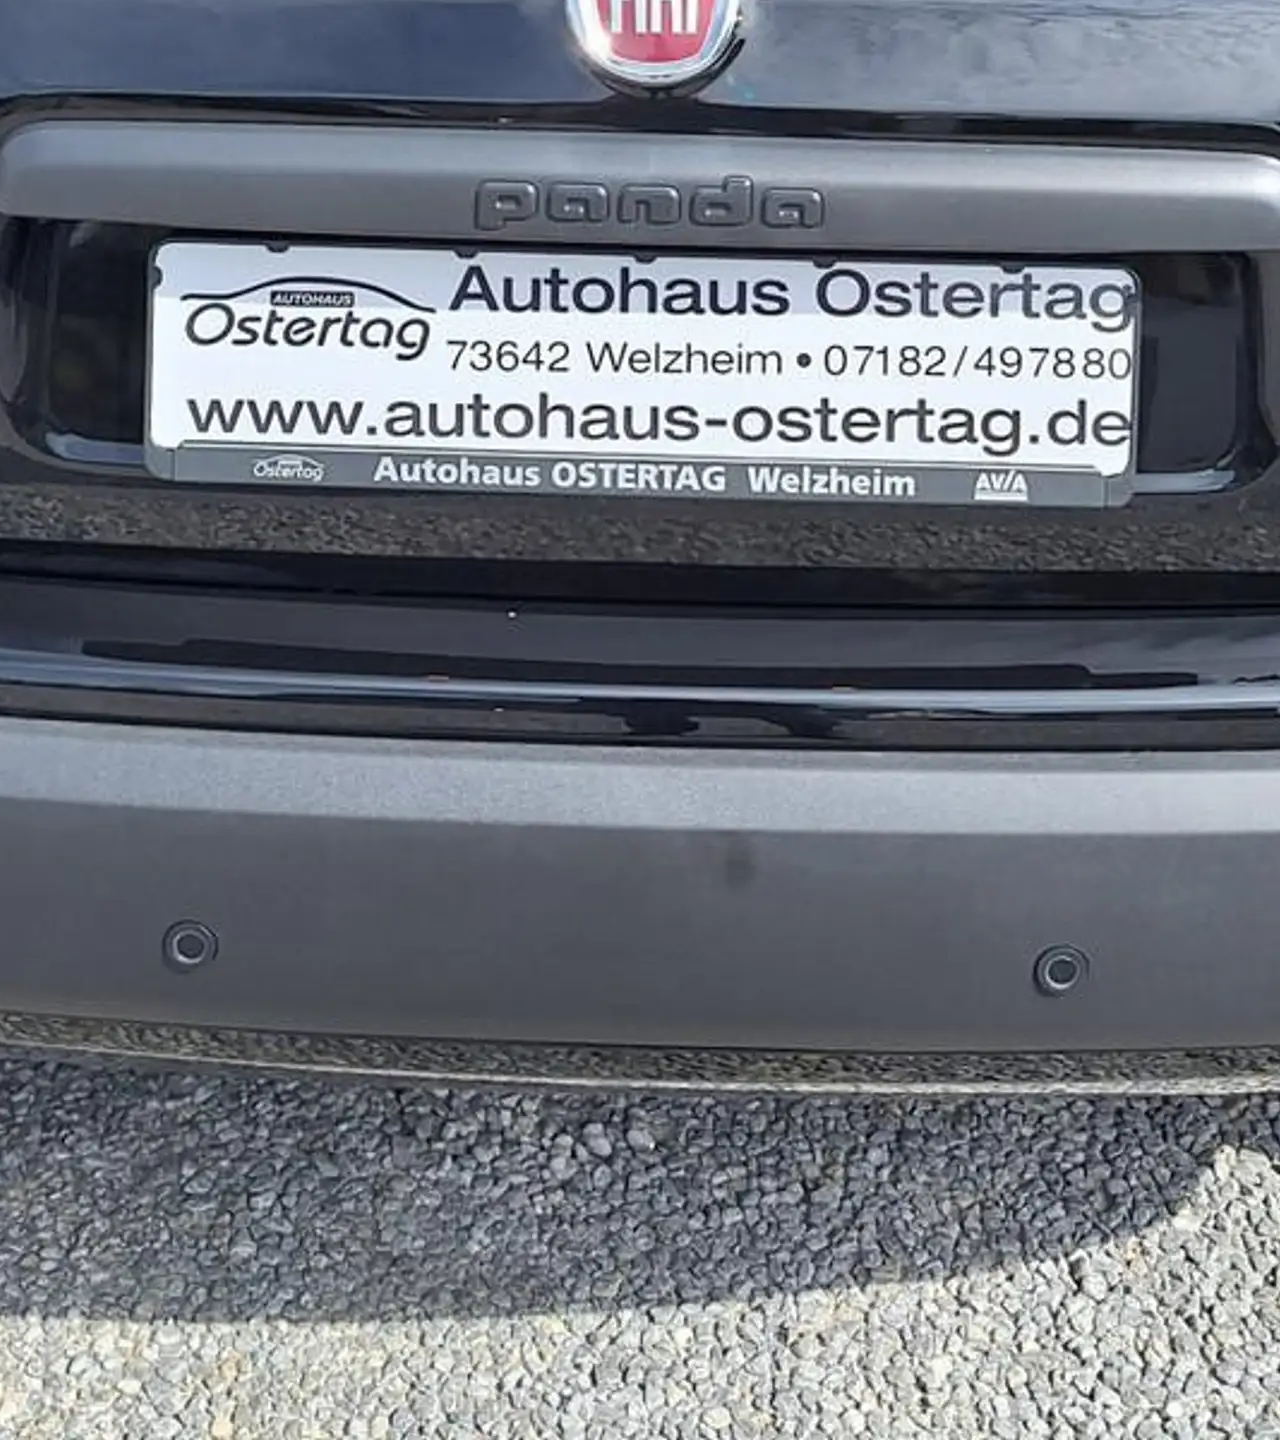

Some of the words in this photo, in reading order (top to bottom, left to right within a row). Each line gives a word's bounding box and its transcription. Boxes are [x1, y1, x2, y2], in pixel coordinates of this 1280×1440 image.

[473, 174, 825, 231] panda
[272, 293, 353, 307] AUTOHAUS
[449, 264, 791, 316] Autohaus
[816, 268, 1133, 333] Ostertag
[184, 303, 430, 361] Ostertag
[446, 339, 571, 373] 73642
[585, 341, 783, 374] Welzheim
[823, 344, 1132, 379] 07182/497880
[186, 391, 1131, 457] www.autohaus-ostertag.de
[253, 461, 325, 482] Ostertag
[373, 455, 542, 487] Autohaus
[552, 460, 727, 492] OSTERTAG
[747, 465, 917, 496] Welzheim
